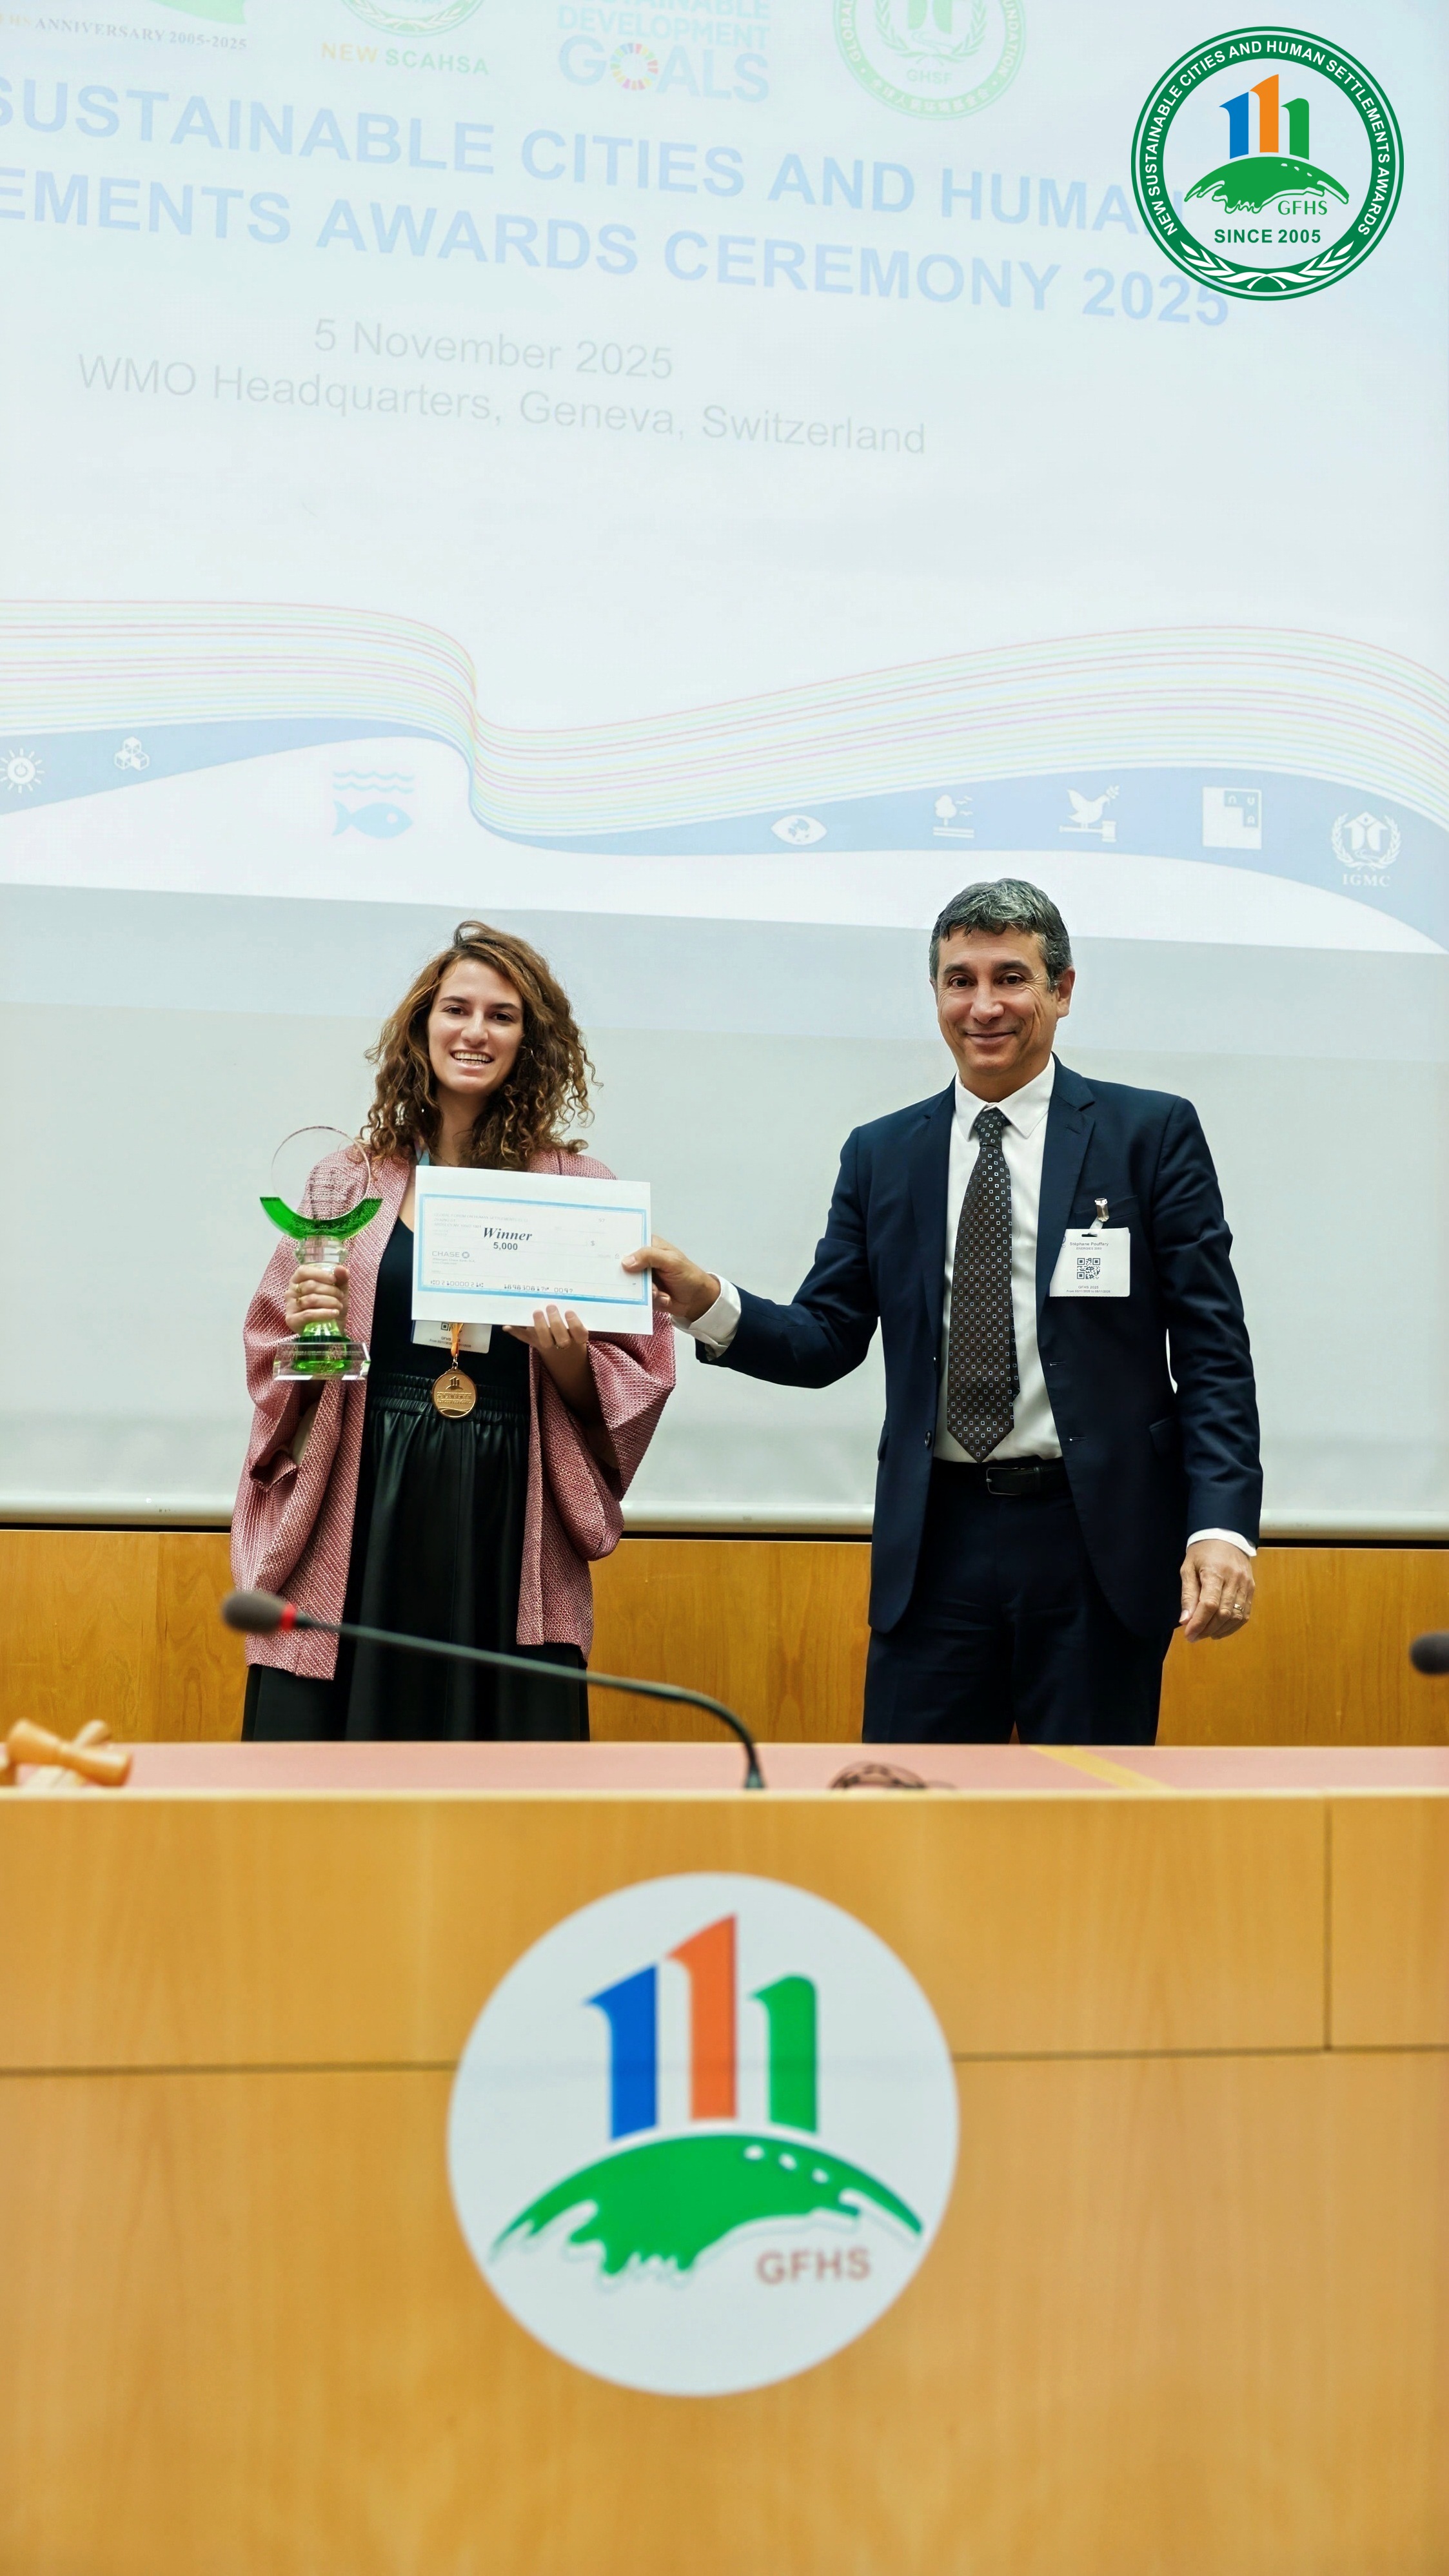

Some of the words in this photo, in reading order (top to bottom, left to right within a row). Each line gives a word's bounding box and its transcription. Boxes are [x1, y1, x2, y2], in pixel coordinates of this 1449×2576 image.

[35, 17, 165, 43] ANNIVERSARY
[170, 30, 247, 50] 2005-2025
[558, 5, 770, 50] DEVELOPMENT
[320, 41, 378, 63] NEW
[386, 48, 489, 75] SCAHSA
[906, 68, 952, 85] GHSF
[521, 128, 745, 198] CITIES
[767, 153, 915, 213] AND
[316, 199, 638, 275] AWARDS
[664, 229, 1061, 311] CEREMONY
[1083, 268, 1230, 327] 2025
[314, 318, 337, 351] 5
[353, 320, 561, 370] November
[576, 339, 673, 379] 2025
[77, 353, 197, 396] WMO
[213, 364, 502, 426] Headquarters,
[520, 389, 685, 442] Geneva,
[702, 404, 927, 456] Switzerland
[1342, 873, 1390, 887] IGMC
[484, 1227, 533, 1241] Winner
[493, 1242, 518, 1251] 5,000
[756, 2247, 872, 2286] GFHS
